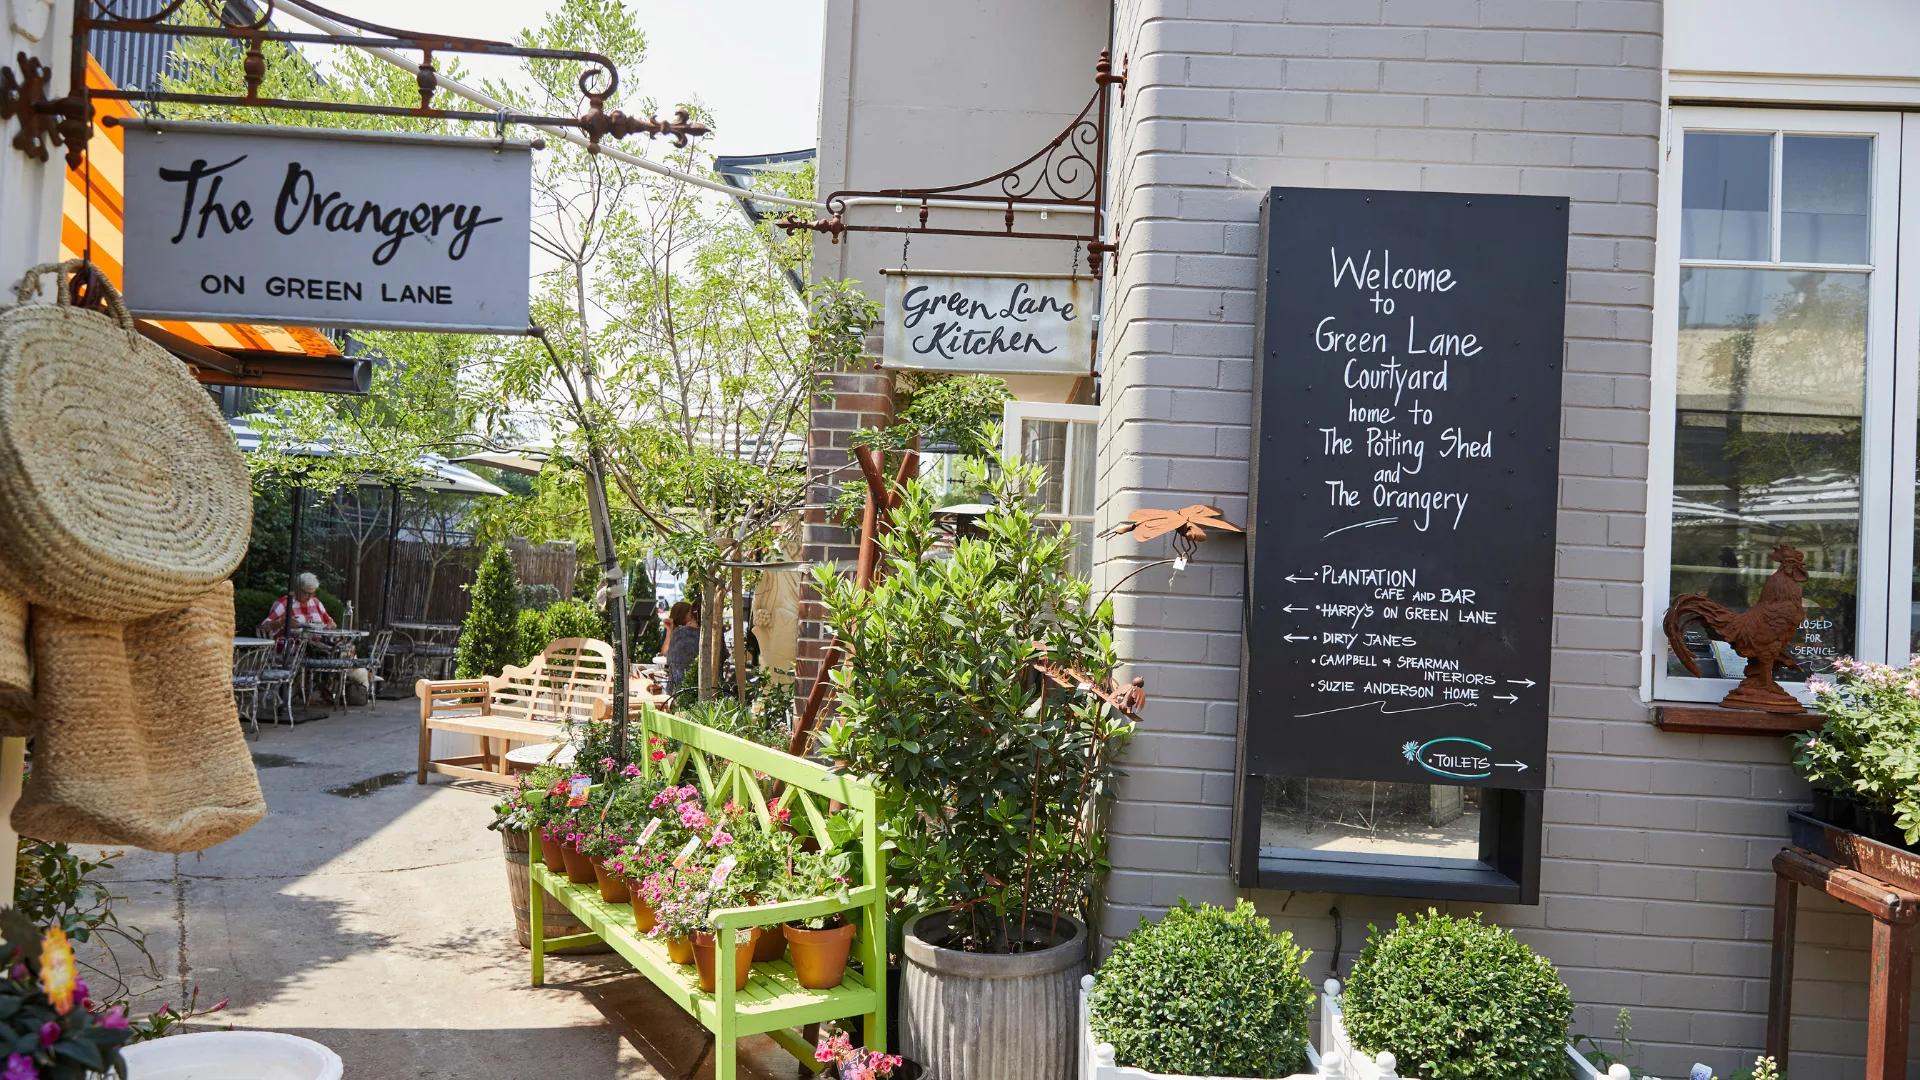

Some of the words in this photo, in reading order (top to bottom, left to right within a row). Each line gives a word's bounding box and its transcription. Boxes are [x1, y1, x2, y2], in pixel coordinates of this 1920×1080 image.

[159, 155, 253, 244] The
[274, 162, 502, 265] Orangery
[1331, 246, 1457, 292] Welcome
[201, 275, 244, 294] ON
[266, 277, 361, 301] GREEN
[382, 284, 452, 304] LANE
[902, 285, 997, 330] Green
[999, 282, 1077, 323] Lane
[1370, 291, 1394, 314] to
[911, 322, 1057, 360] Kitchen
[1316, 317, 1385, 352] Green
[1408, 316, 1483, 356] Lane
[1344, 355, 1448, 407] Courtyard
[1348, 398, 1396, 424] home
[1408, 400, 1432, 424] to
[1319, 427, 1352, 455] The
[1366, 427, 1425, 475] Potting
[1439, 427, 1491, 458] Shed
[1374, 462, 1401, 484] and
[1325, 480, 1360, 506] The
[1373, 484, 1469, 532] Orangery
[1322, 565, 1416, 587] PLANTATION
[1375, 588, 1404, 600] CAFE
[1412, 591, 1435, 601] AND
[1440, 589, 1475, 604] BAR
[1321, 604, 1374, 629] HARRY'S
[1384, 606, 1398, 618] ON
[1405, 607, 1448, 621] GREEN
[1459, 610, 1497, 624] LANE
[1797, 619, 1833, 630] LOSED
[1323, 632, 1358, 649] DIRTY
[1363, 634, 1416, 646] JANES
[1805, 633, 1823, 643] FOR
[1320, 654, 1377, 666] CAMPBELL
[1397, 656, 1458, 670] SPEARMAN
[1790, 645, 1839, 656] SERVICE
[1318, 680, 1354, 691] SUZIE
[1364, 682, 1433, 698] ANDERSON
[1443, 687, 1479, 699] HOME
[1424, 671, 1497, 685] INTERIORS
[1432, 753, 1491, 770] TOILETS
